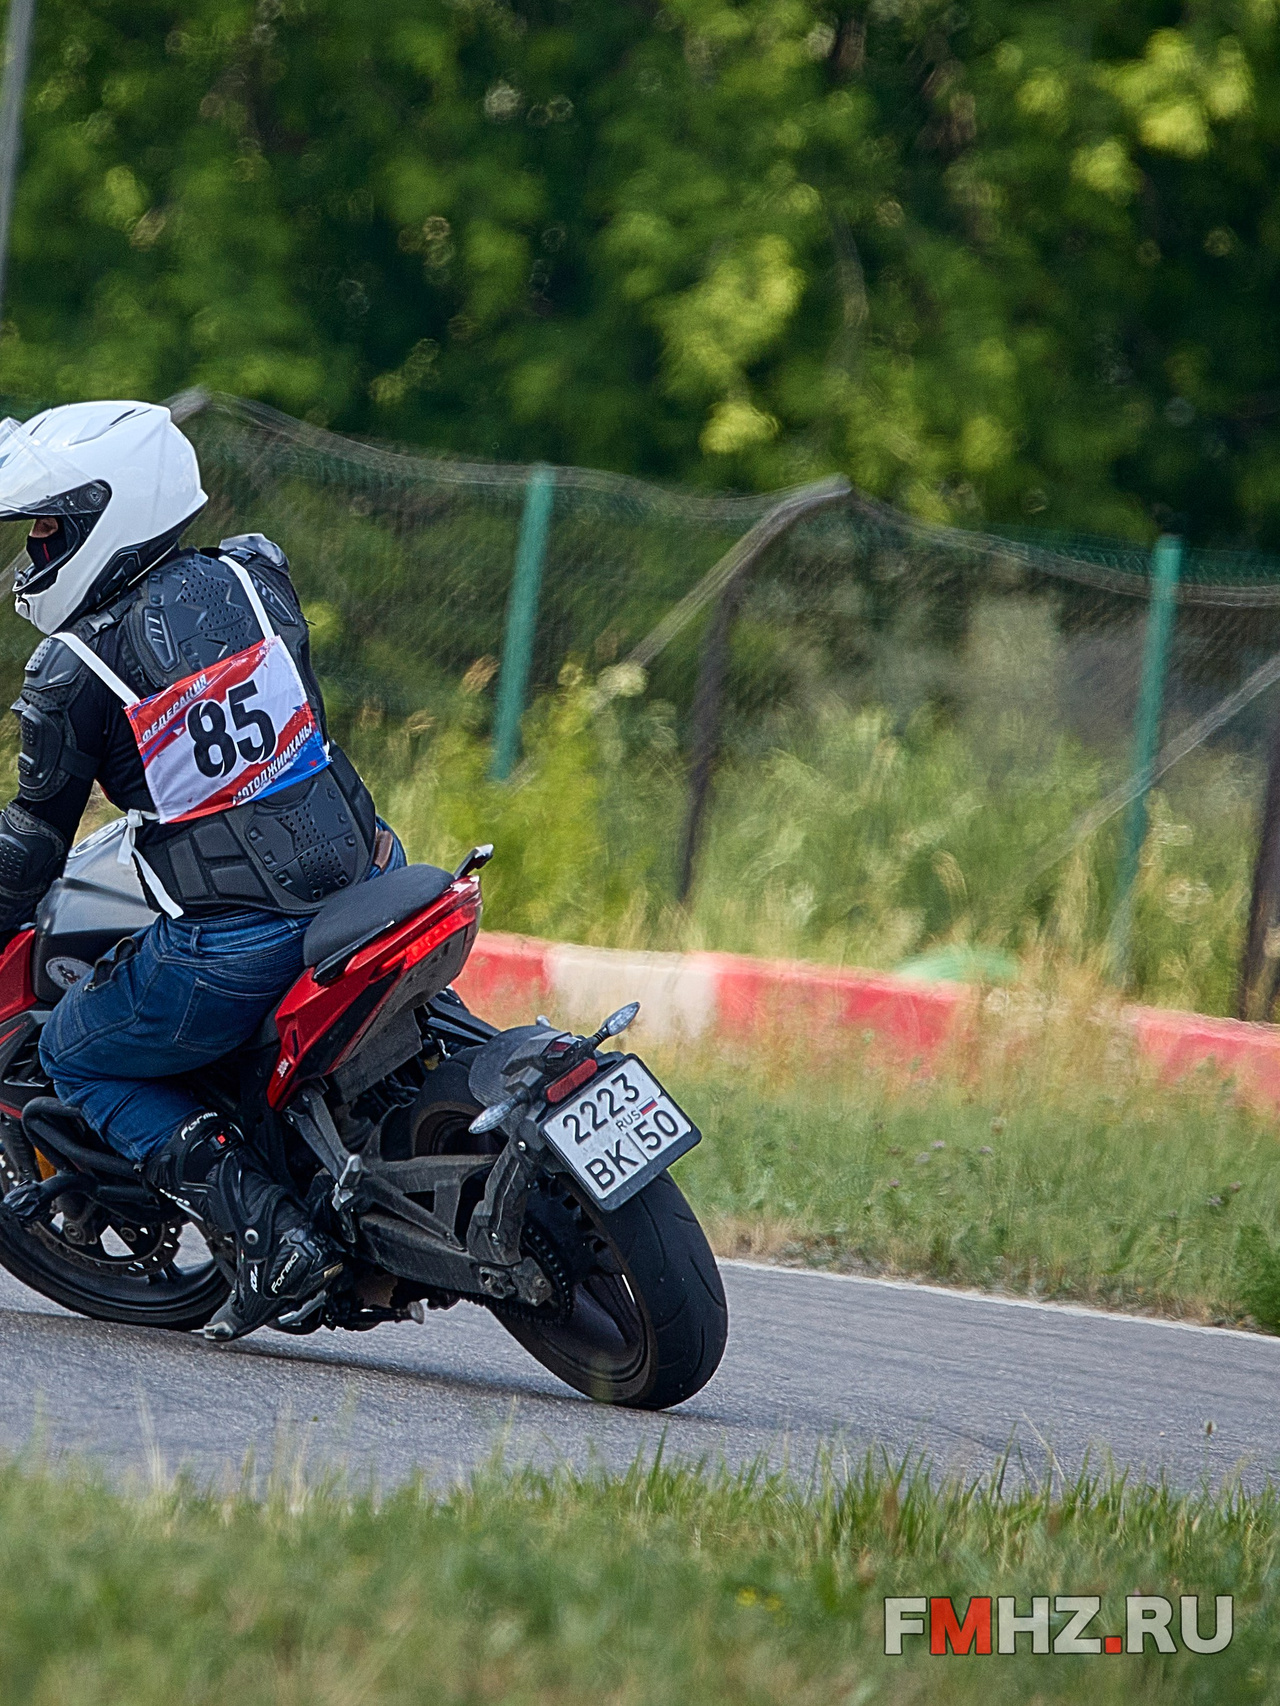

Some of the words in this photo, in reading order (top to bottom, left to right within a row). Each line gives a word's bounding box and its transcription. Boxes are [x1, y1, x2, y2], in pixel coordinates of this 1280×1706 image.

[142, 674, 208, 743] ФЕДЕРАЦИЯ
[186, 679, 278, 778] 85
[562, 1072, 640, 1145] 2223
[615, 1110, 641, 1135] RUS
[584, 1139, 639, 1192] BK
[633, 1110, 679, 1151] 50
